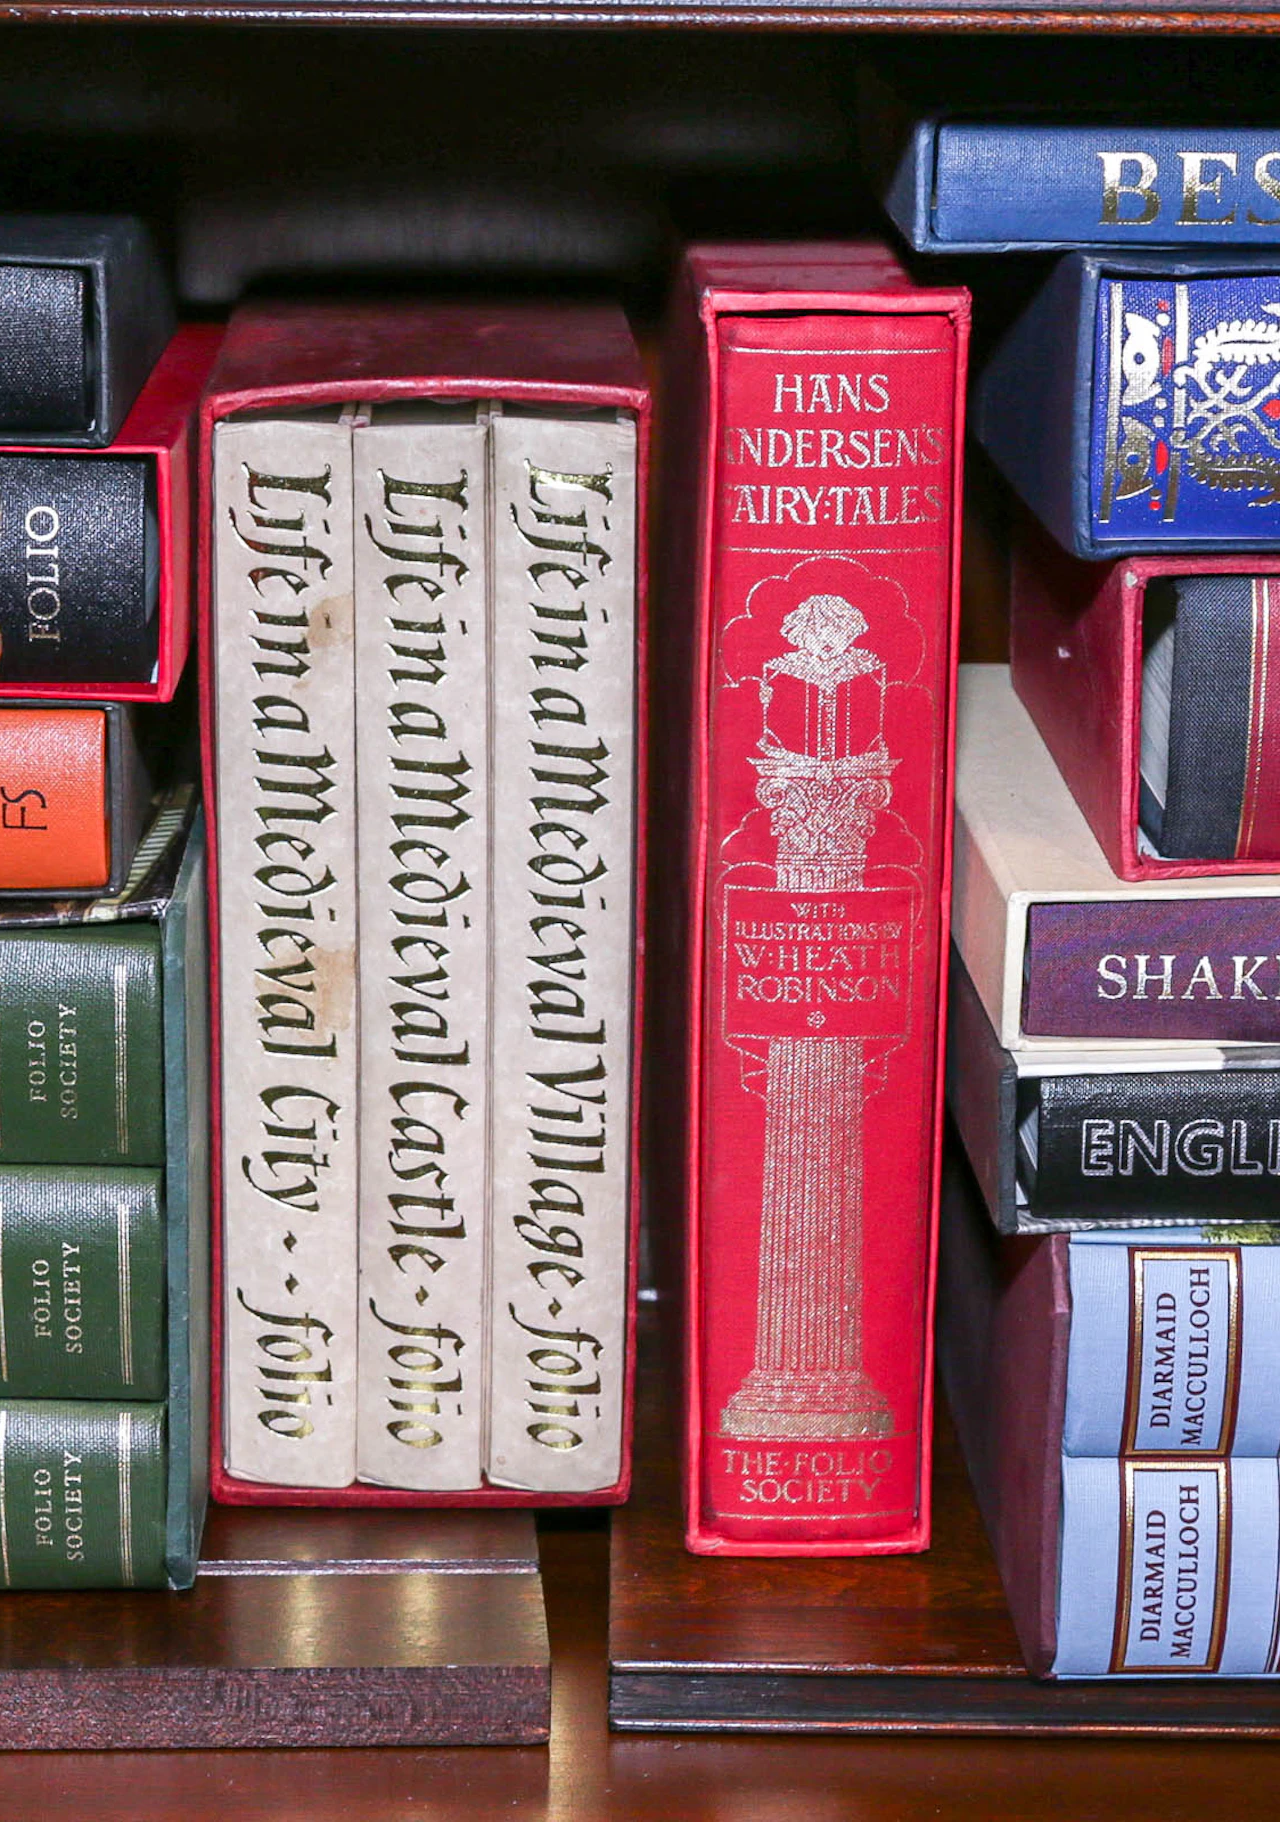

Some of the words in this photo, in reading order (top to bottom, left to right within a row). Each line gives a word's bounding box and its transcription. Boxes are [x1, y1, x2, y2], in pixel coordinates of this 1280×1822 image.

[773, 374, 890, 413] HANS
[28, 505, 61, 643] FOLIO
[229, 461, 333, 598] Life
[365, 467, 470, 600] Life
[509, 458, 613, 592] Life
[249, 606, 332, 683] in
[386, 612, 469, 690] in
[529, 601, 609, 675] in
[251, 695, 310, 739] a
[388, 701, 448, 746] a
[529, 687, 587, 730] a
[1, 787, 47, 831] FS
[253, 744, 340, 1058] Medieval
[388, 750, 473, 1065] Medieval
[526, 736, 611, 1044] Medieval
[791, 903, 846, 918] WITH
[736, 973, 900, 1003] ROBINSON
[28, 1020, 47, 1101] FOLIO
[59, 1003, 78, 1119] SOCIETY
[241, 1084, 343, 1213] City
[388, 1082, 470, 1274] Castle
[513, 1054, 608, 1289] Village
[31, 1257, 52, 1339] FOLIO
[62, 1240, 83, 1355] SOCIETY
[237, 1286, 335, 1439] folio
[369, 1297, 465, 1448] folio
[509, 1302, 605, 1450] folio
[1148, 1292, 1179, 1429] DIARMAID
[1180, 1266, 1211, 1446] MACCULLOCH
[35, 1467, 54, 1549] FOLIO
[65, 1450, 84, 1563] SOCIETY
[723, 1450, 783, 1476] THE
[795, 1450, 893, 1476] FOLIO
[739, 1478, 882, 1504] SOCIETY
[1139, 1509, 1168, 1644] DIARMAID
[1170, 1484, 1200, 1660] MACCULLOCH
